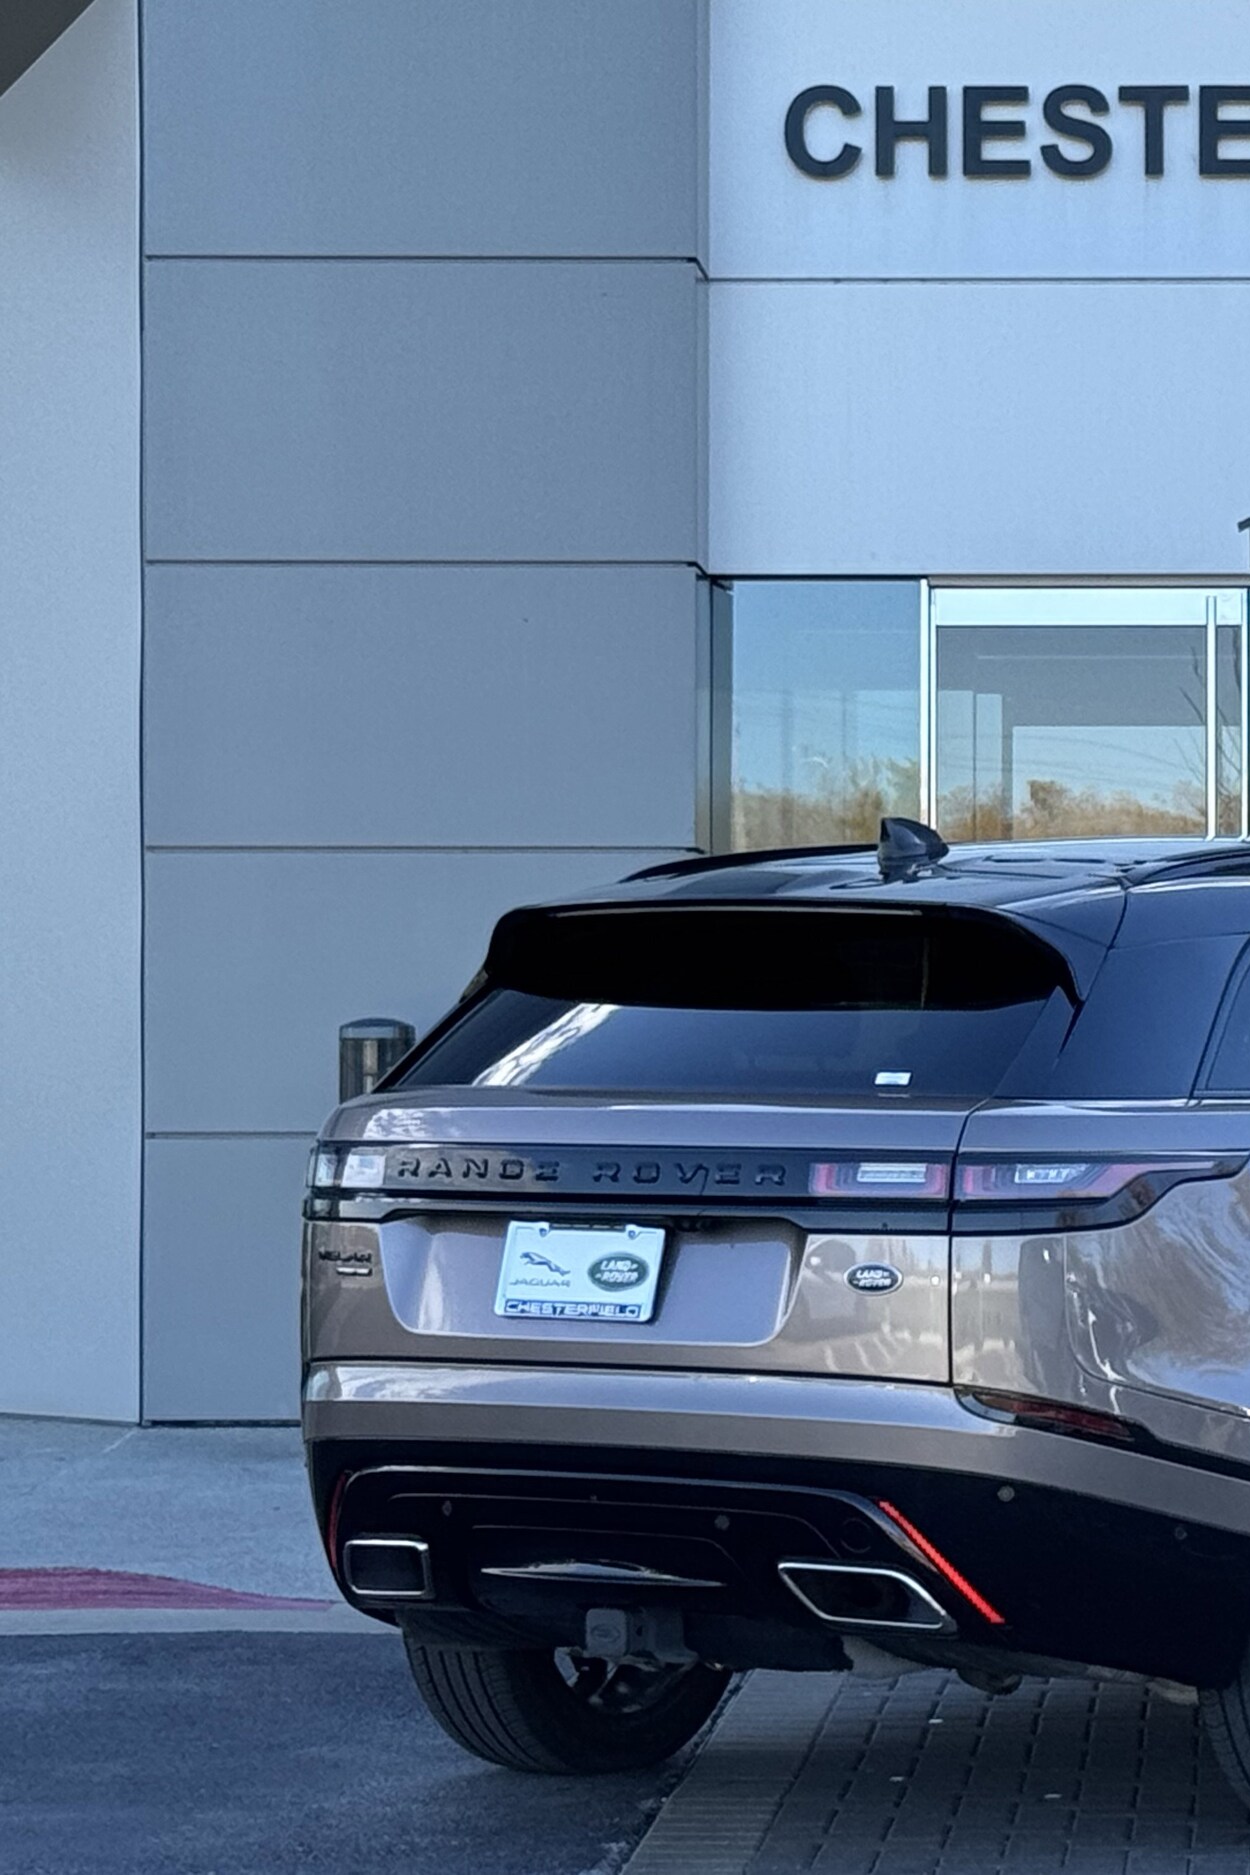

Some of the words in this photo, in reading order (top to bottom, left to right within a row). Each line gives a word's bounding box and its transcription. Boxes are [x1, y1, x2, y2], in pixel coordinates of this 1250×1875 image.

[592, 1161, 786, 1186] ROVER
[508, 1277, 571, 1288] JAGUAR
[505, 1300, 640, 1318] CHESTERFIELD
